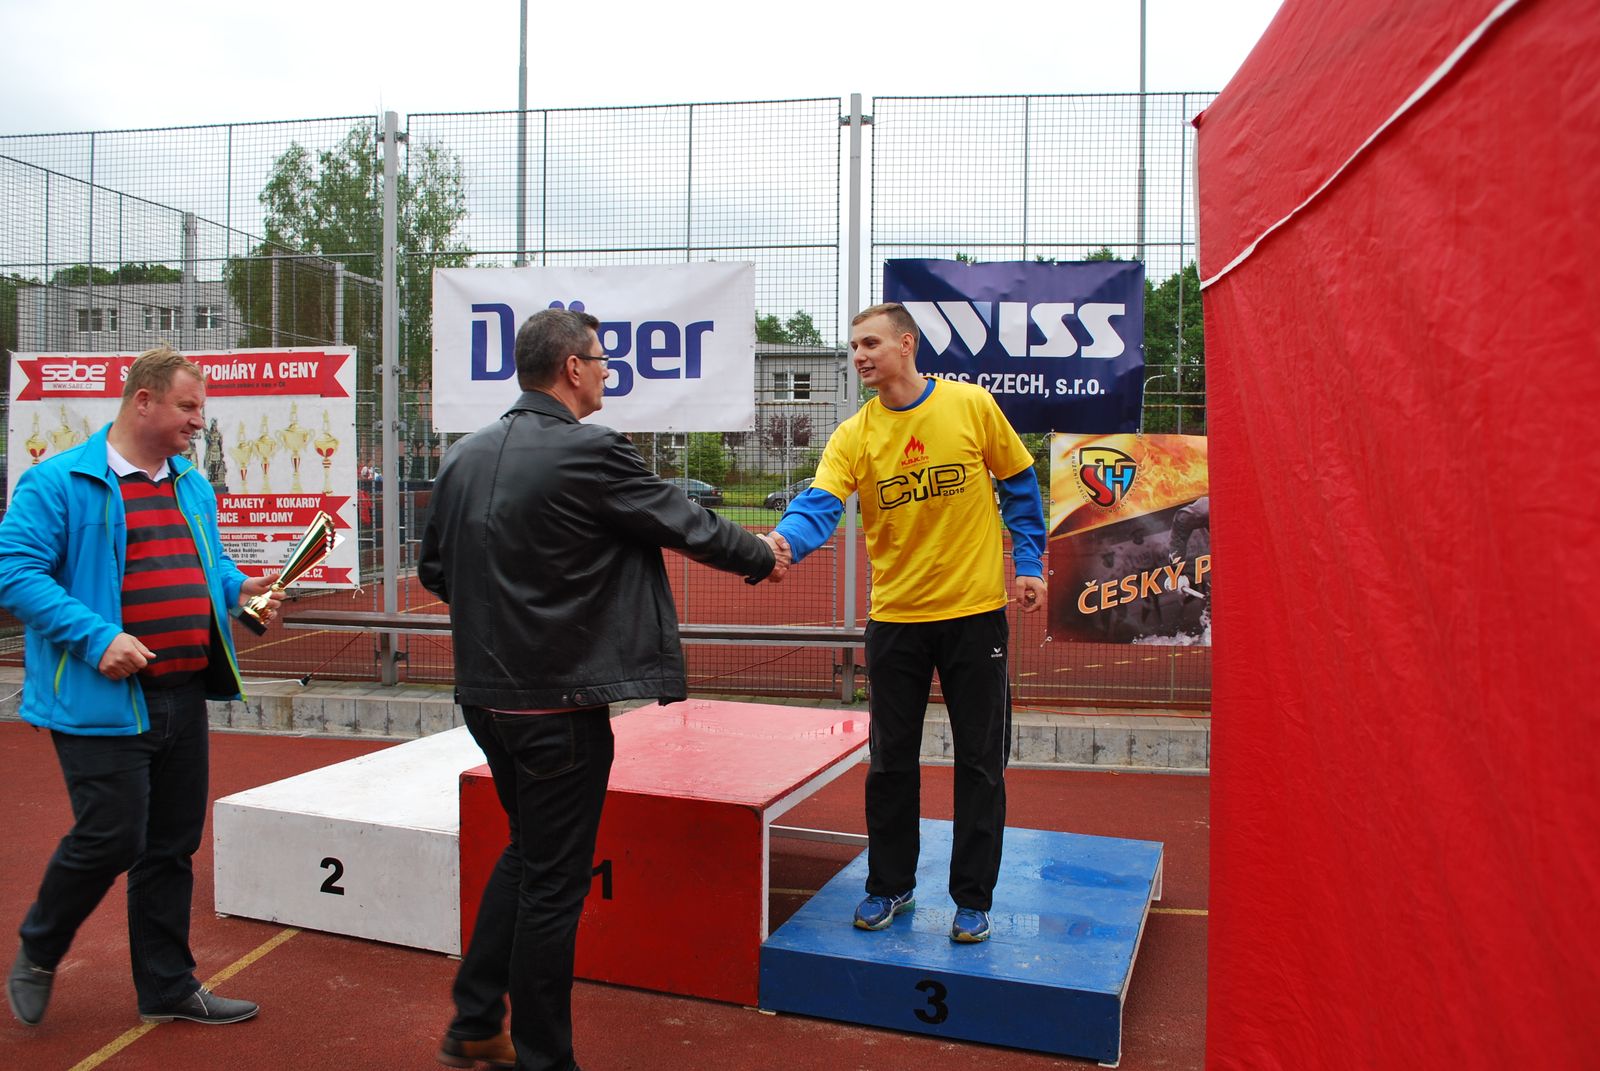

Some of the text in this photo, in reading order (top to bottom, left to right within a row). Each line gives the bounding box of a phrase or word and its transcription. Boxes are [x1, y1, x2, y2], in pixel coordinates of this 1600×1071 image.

[471, 300, 714, 397] Dger
[902, 301, 1125, 358] WISS
[41, 360, 107, 381] sabe
[202, 359, 319, 381] POHÁRY A CENY
[977, 373, 1050, 398] CZECH,
[1055, 378, 1106, 395] s.r.o.
[222, 497, 321, 509] PLAKETY KOKARDY
[249, 511, 294, 523] DIPLOMY
[1077, 556, 1186, 615] ČESKÝ
[320, 857, 345, 896] 2
[592, 859, 612, 900] 1
[913, 980, 948, 1025] 3
